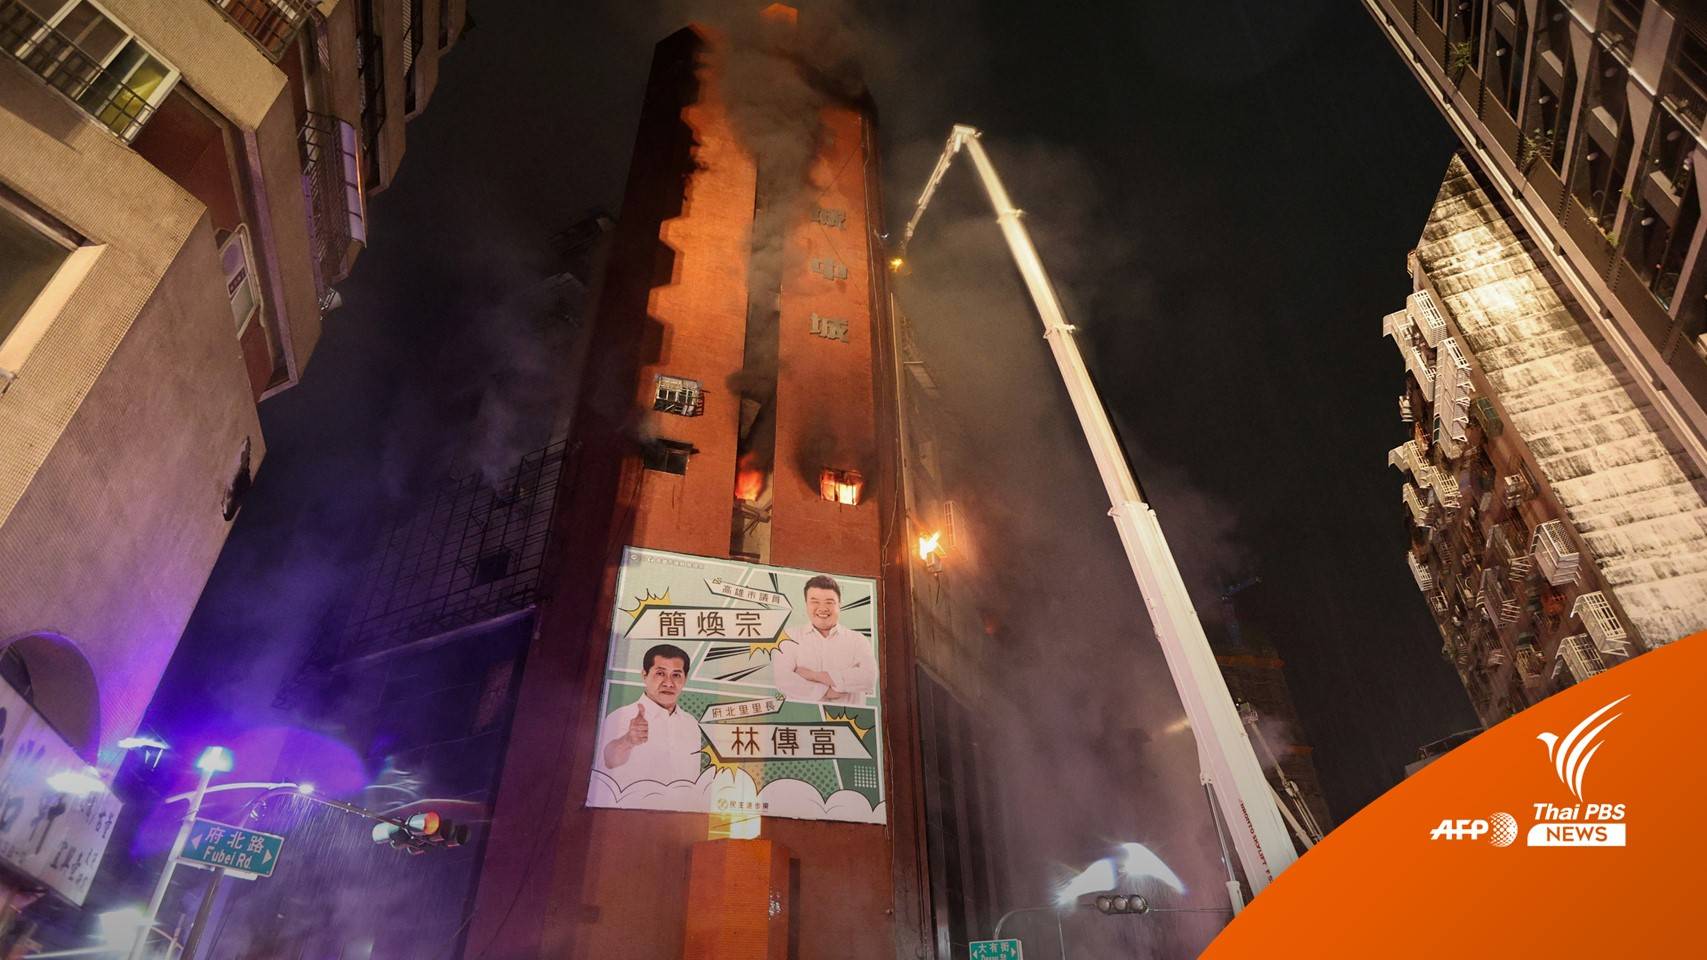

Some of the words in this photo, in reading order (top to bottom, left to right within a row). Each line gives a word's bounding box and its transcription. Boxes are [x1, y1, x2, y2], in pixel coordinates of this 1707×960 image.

[722, 585, 780, 604] 高雄市議員
[659, 611, 761, 637] 簡煥宗
[712, 701, 776, 718] 府北里里長
[731, 726, 836, 756] 林傳富
[205, 826, 264, 853] 府北路
[203, 845, 237, 865] Fubei
[979, 942, 1009, 953] 大有街
